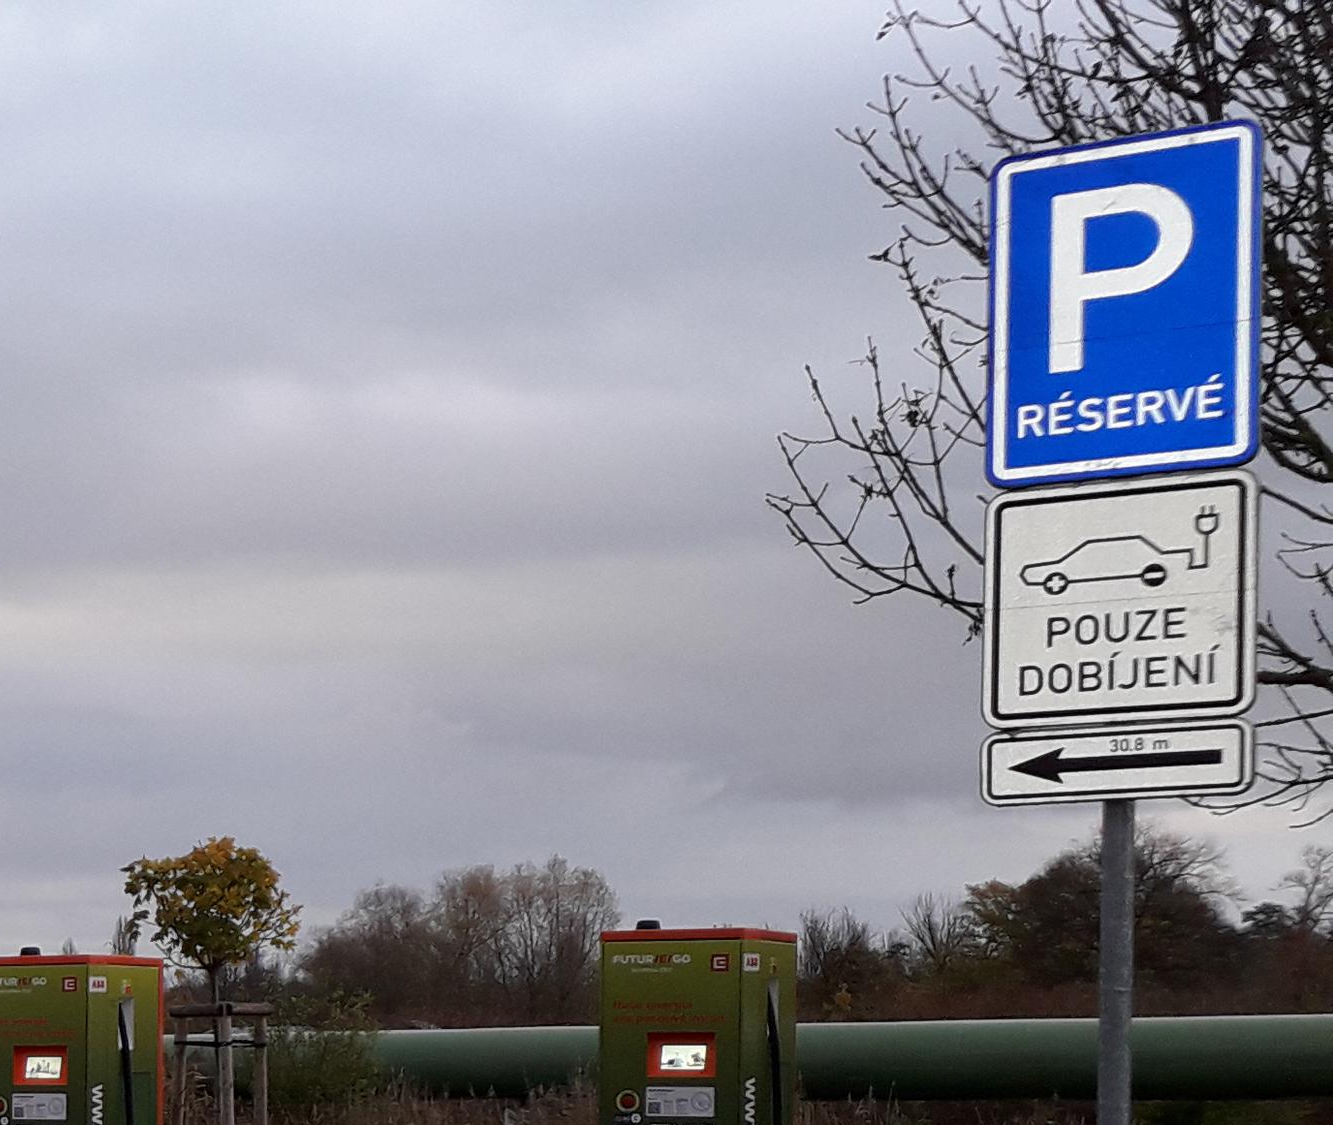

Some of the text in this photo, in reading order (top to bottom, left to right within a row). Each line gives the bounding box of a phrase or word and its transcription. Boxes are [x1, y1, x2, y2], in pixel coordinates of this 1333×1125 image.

[1049, 182, 1195, 375] P
[1016, 374, 1226, 439] RÉSERVÉ
[1046, 606, 1187, 649] POUZE
[1018, 643, 1221, 696] DOBÍJENÍ
[1108, 737, 1169, 753] 30.8 m
